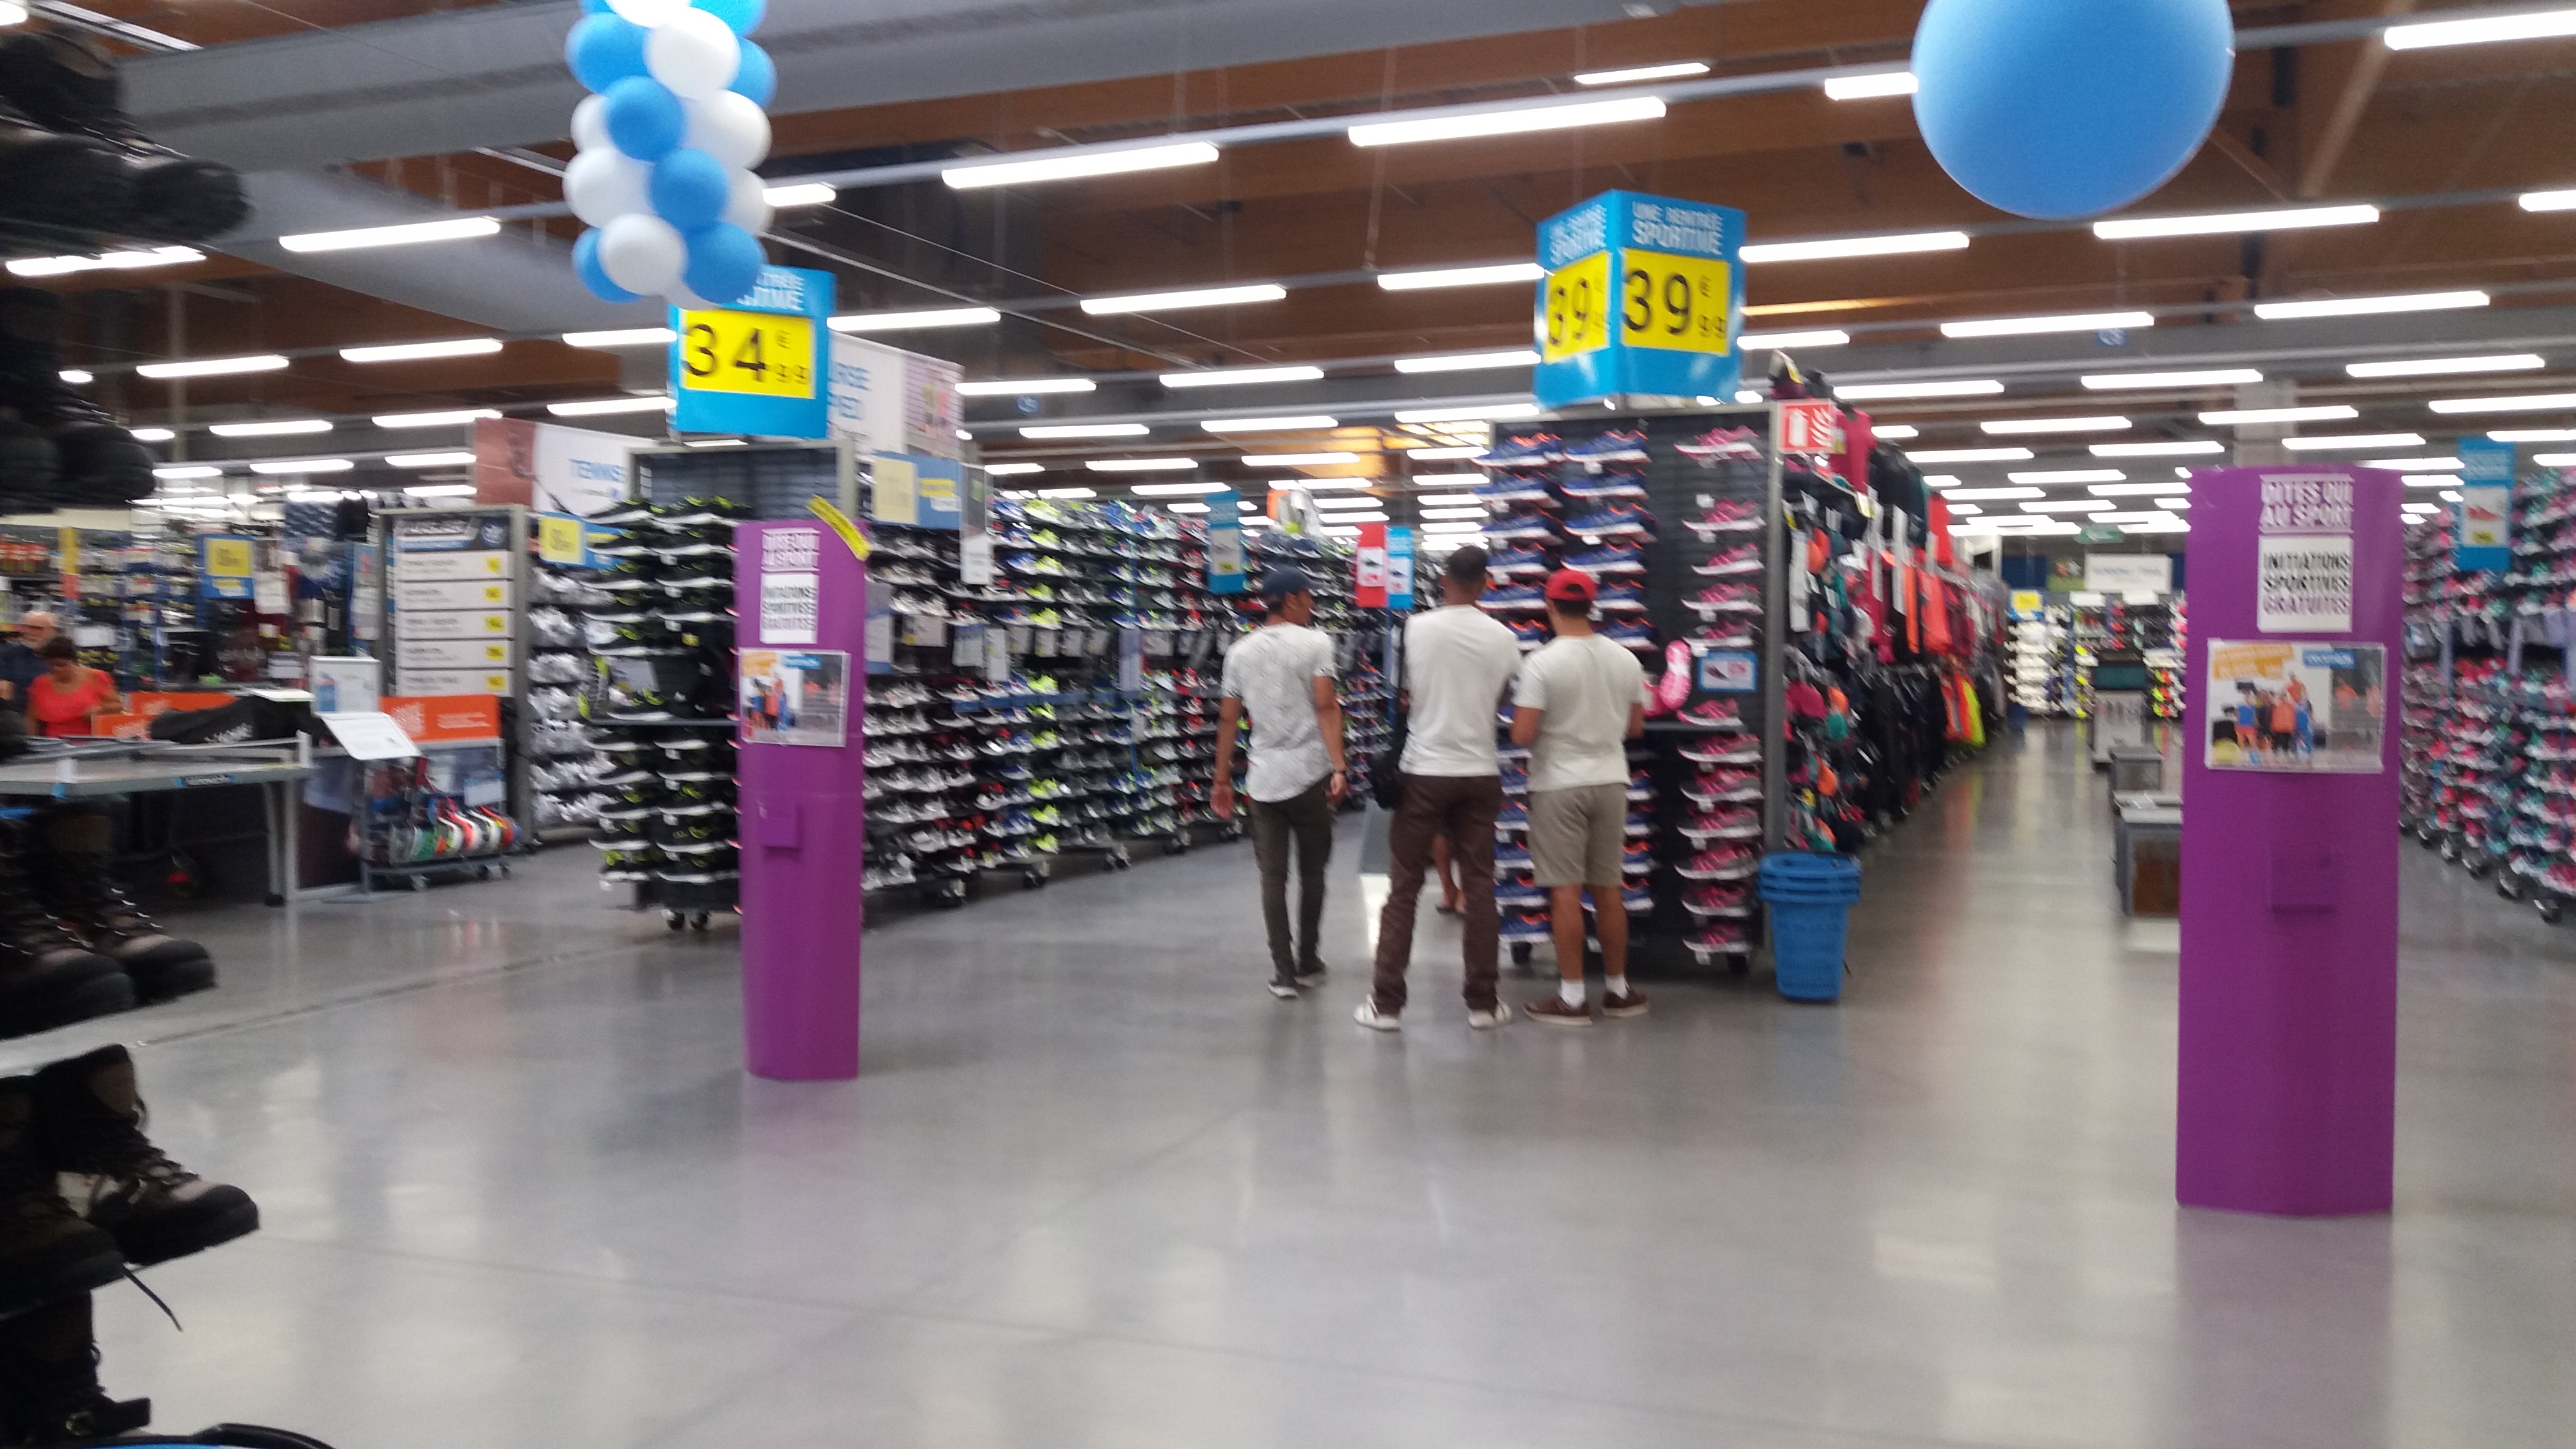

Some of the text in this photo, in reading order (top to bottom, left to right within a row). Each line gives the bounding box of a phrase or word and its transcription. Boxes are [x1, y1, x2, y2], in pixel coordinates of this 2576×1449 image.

[1632, 201, 1662, 222] UNE
[1632, 221, 1723, 255] SPORTIVE
[1549, 277, 1592, 347] 39
[1624, 269, 1693, 336] 39
[682, 323, 766, 383] 34
[569, 457, 626, 484] TENNIS
[2291, 504, 2354, 529] SPORT
[2263, 550, 2351, 572] INITIATIONS
[2263, 573, 2351, 595] SPORTIVES
[2263, 595, 2350, 615] GRATUITES
